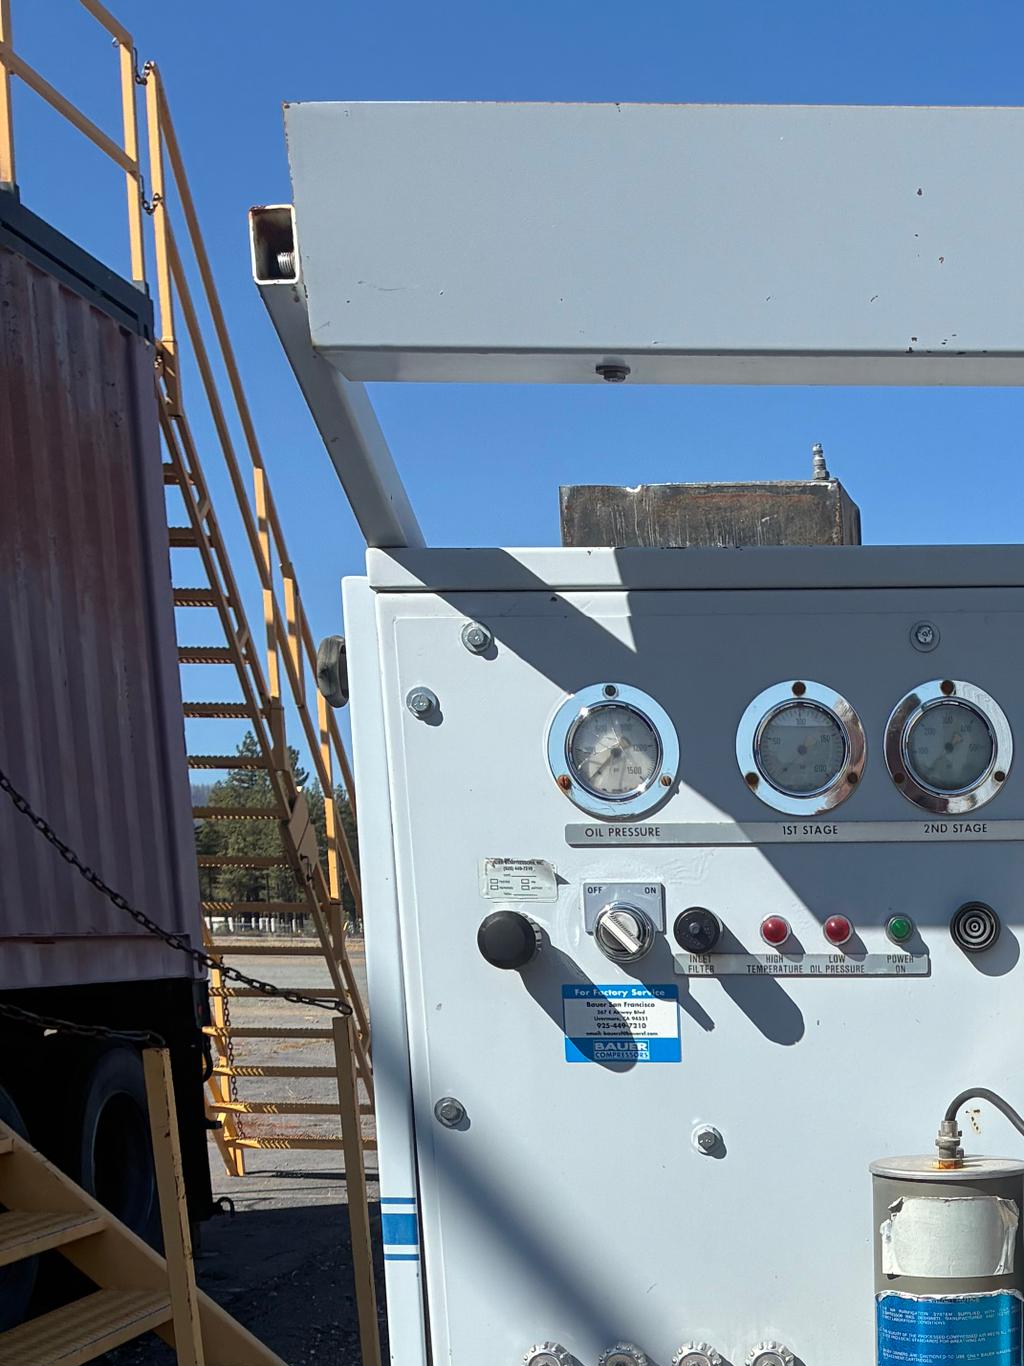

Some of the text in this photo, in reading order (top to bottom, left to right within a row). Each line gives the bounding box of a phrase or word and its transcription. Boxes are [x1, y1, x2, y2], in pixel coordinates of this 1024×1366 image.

[627, 766, 642, 775] 1500
[585, 826, 661, 838] OIL PRESSURE
[782, 824, 838, 836] 1ST STAGE
[923, 823, 988, 834] 2ND STAGE
[689, 955, 712, 964] INLET
[766, 954, 784, 963] HIGH
[829, 955, 846, 963] LOW
[887, 955, 914, 964] POWER
[688, 964, 715, 973] FILTER
[747, 964, 804, 974] TEMPERATURE
[810, 964, 865, 973] OIL PRESSURE
[895, 965, 906, 973] ON
[593, 989, 628, 998] Factory
[595, 1042, 647, 1050] BAUER
